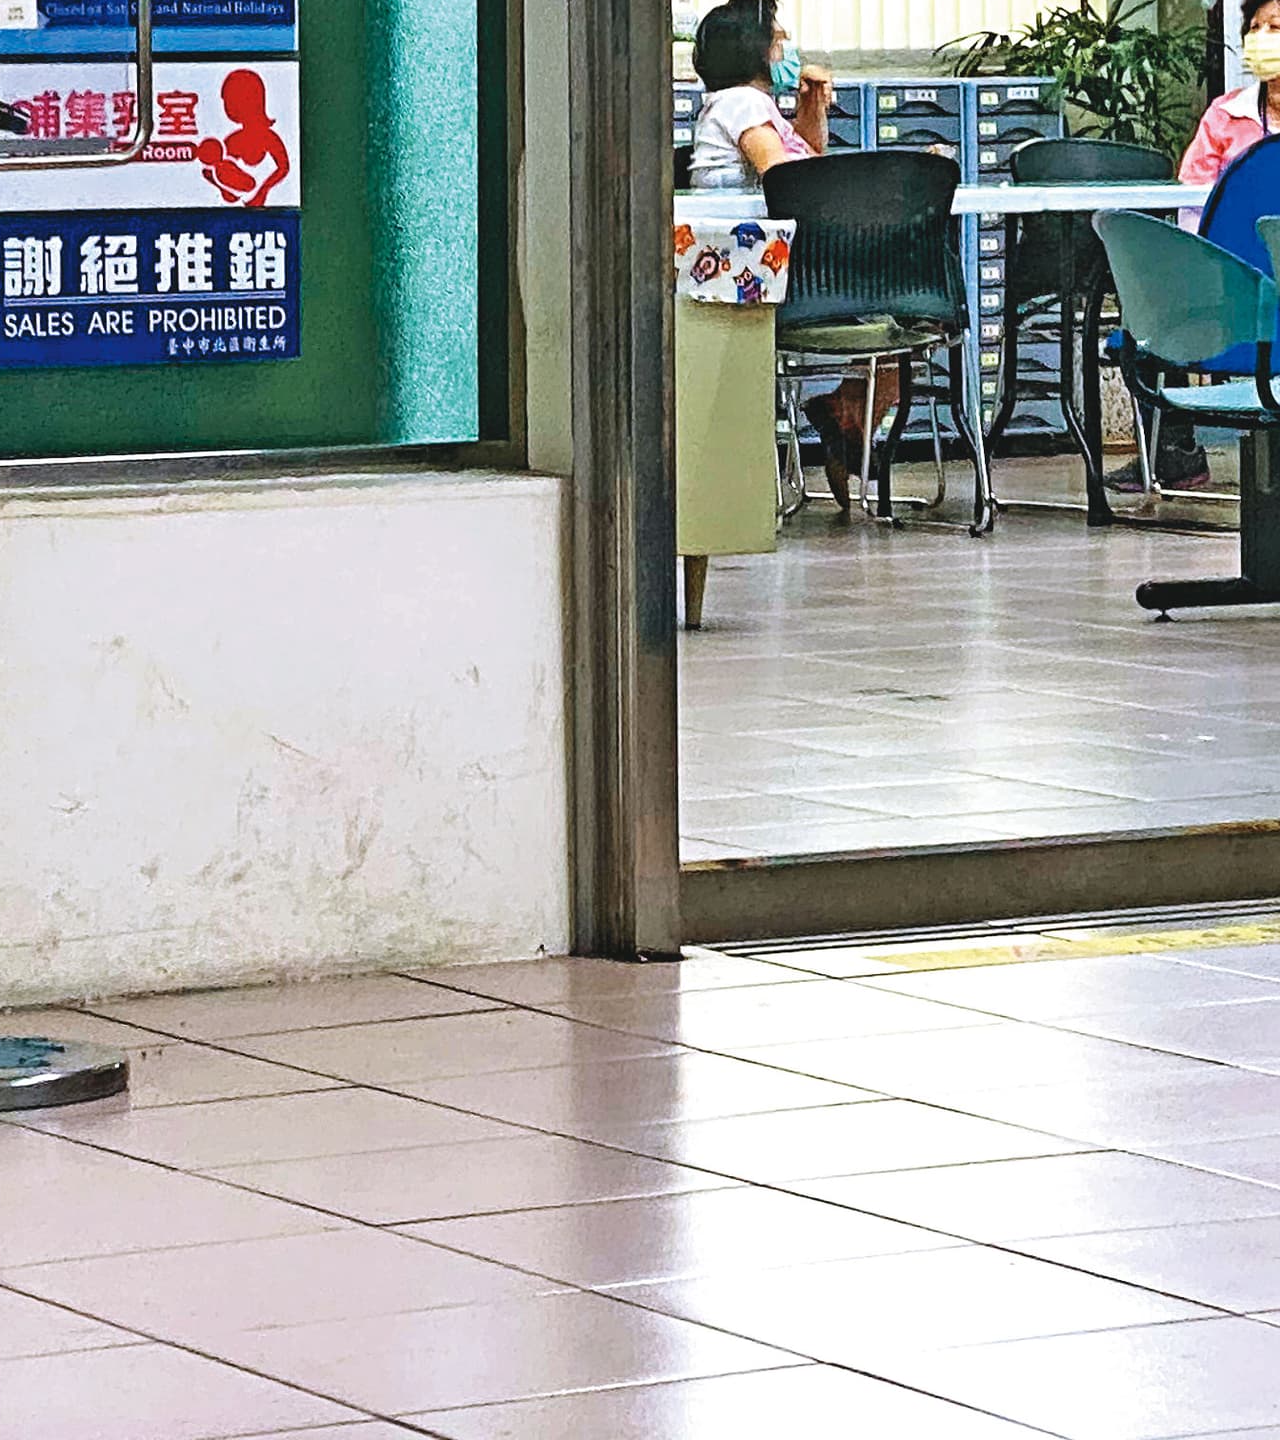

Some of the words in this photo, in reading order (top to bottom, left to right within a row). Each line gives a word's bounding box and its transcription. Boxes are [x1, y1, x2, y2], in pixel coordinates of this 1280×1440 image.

[156, 1, 177, 14] and
[182, 1, 231, 14] National
[234, 1, 284, 15] Holidays
[142, 144, 192, 161] Room
[3, 231, 287, 297] 謝絕推銷
[4, 312, 74, 338] SALES
[88, 310, 134, 334] ARE
[149, 306, 286, 332] PROHIBITED
